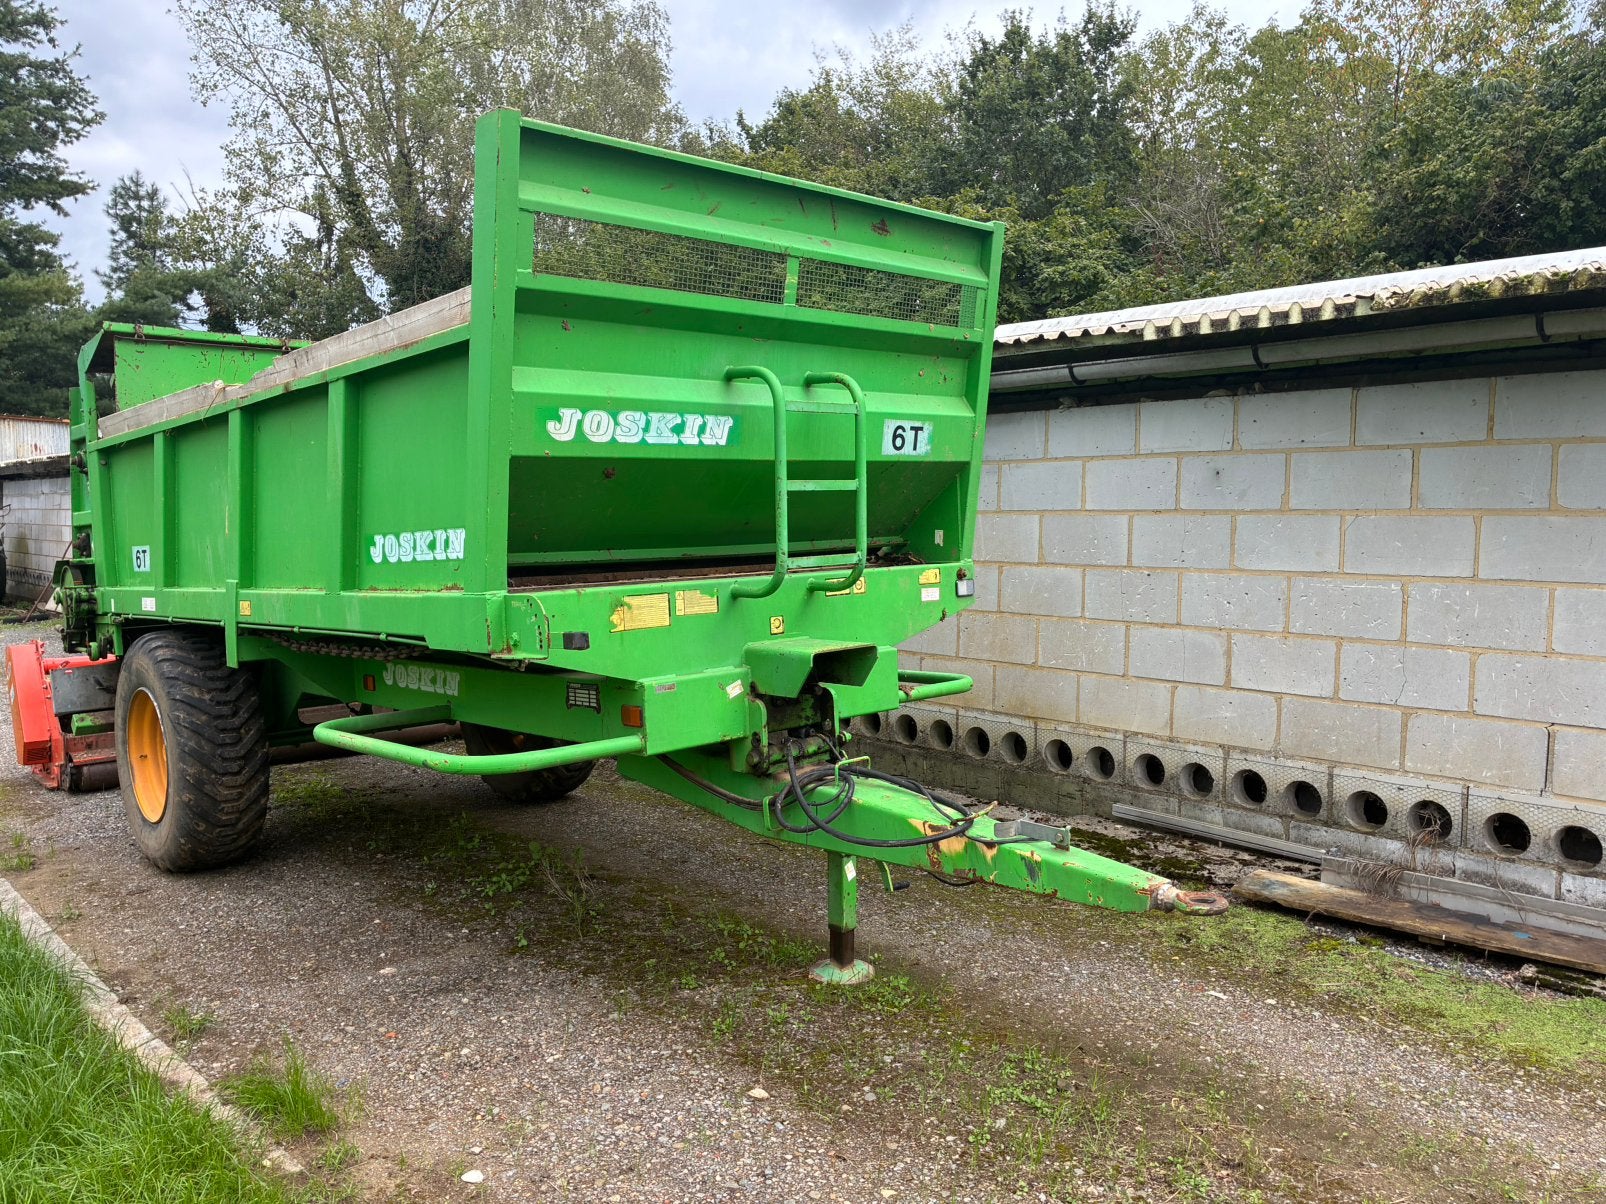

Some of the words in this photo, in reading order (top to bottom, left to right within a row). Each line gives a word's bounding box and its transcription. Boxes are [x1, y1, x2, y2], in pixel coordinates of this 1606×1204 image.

[546, 407, 733, 446] JOSKIN
[891, 424, 924, 452] 6T
[135, 548, 148, 570] 6T
[370, 527, 465, 564] JOSKIN
[382, 662, 460, 697] JOSKIN
